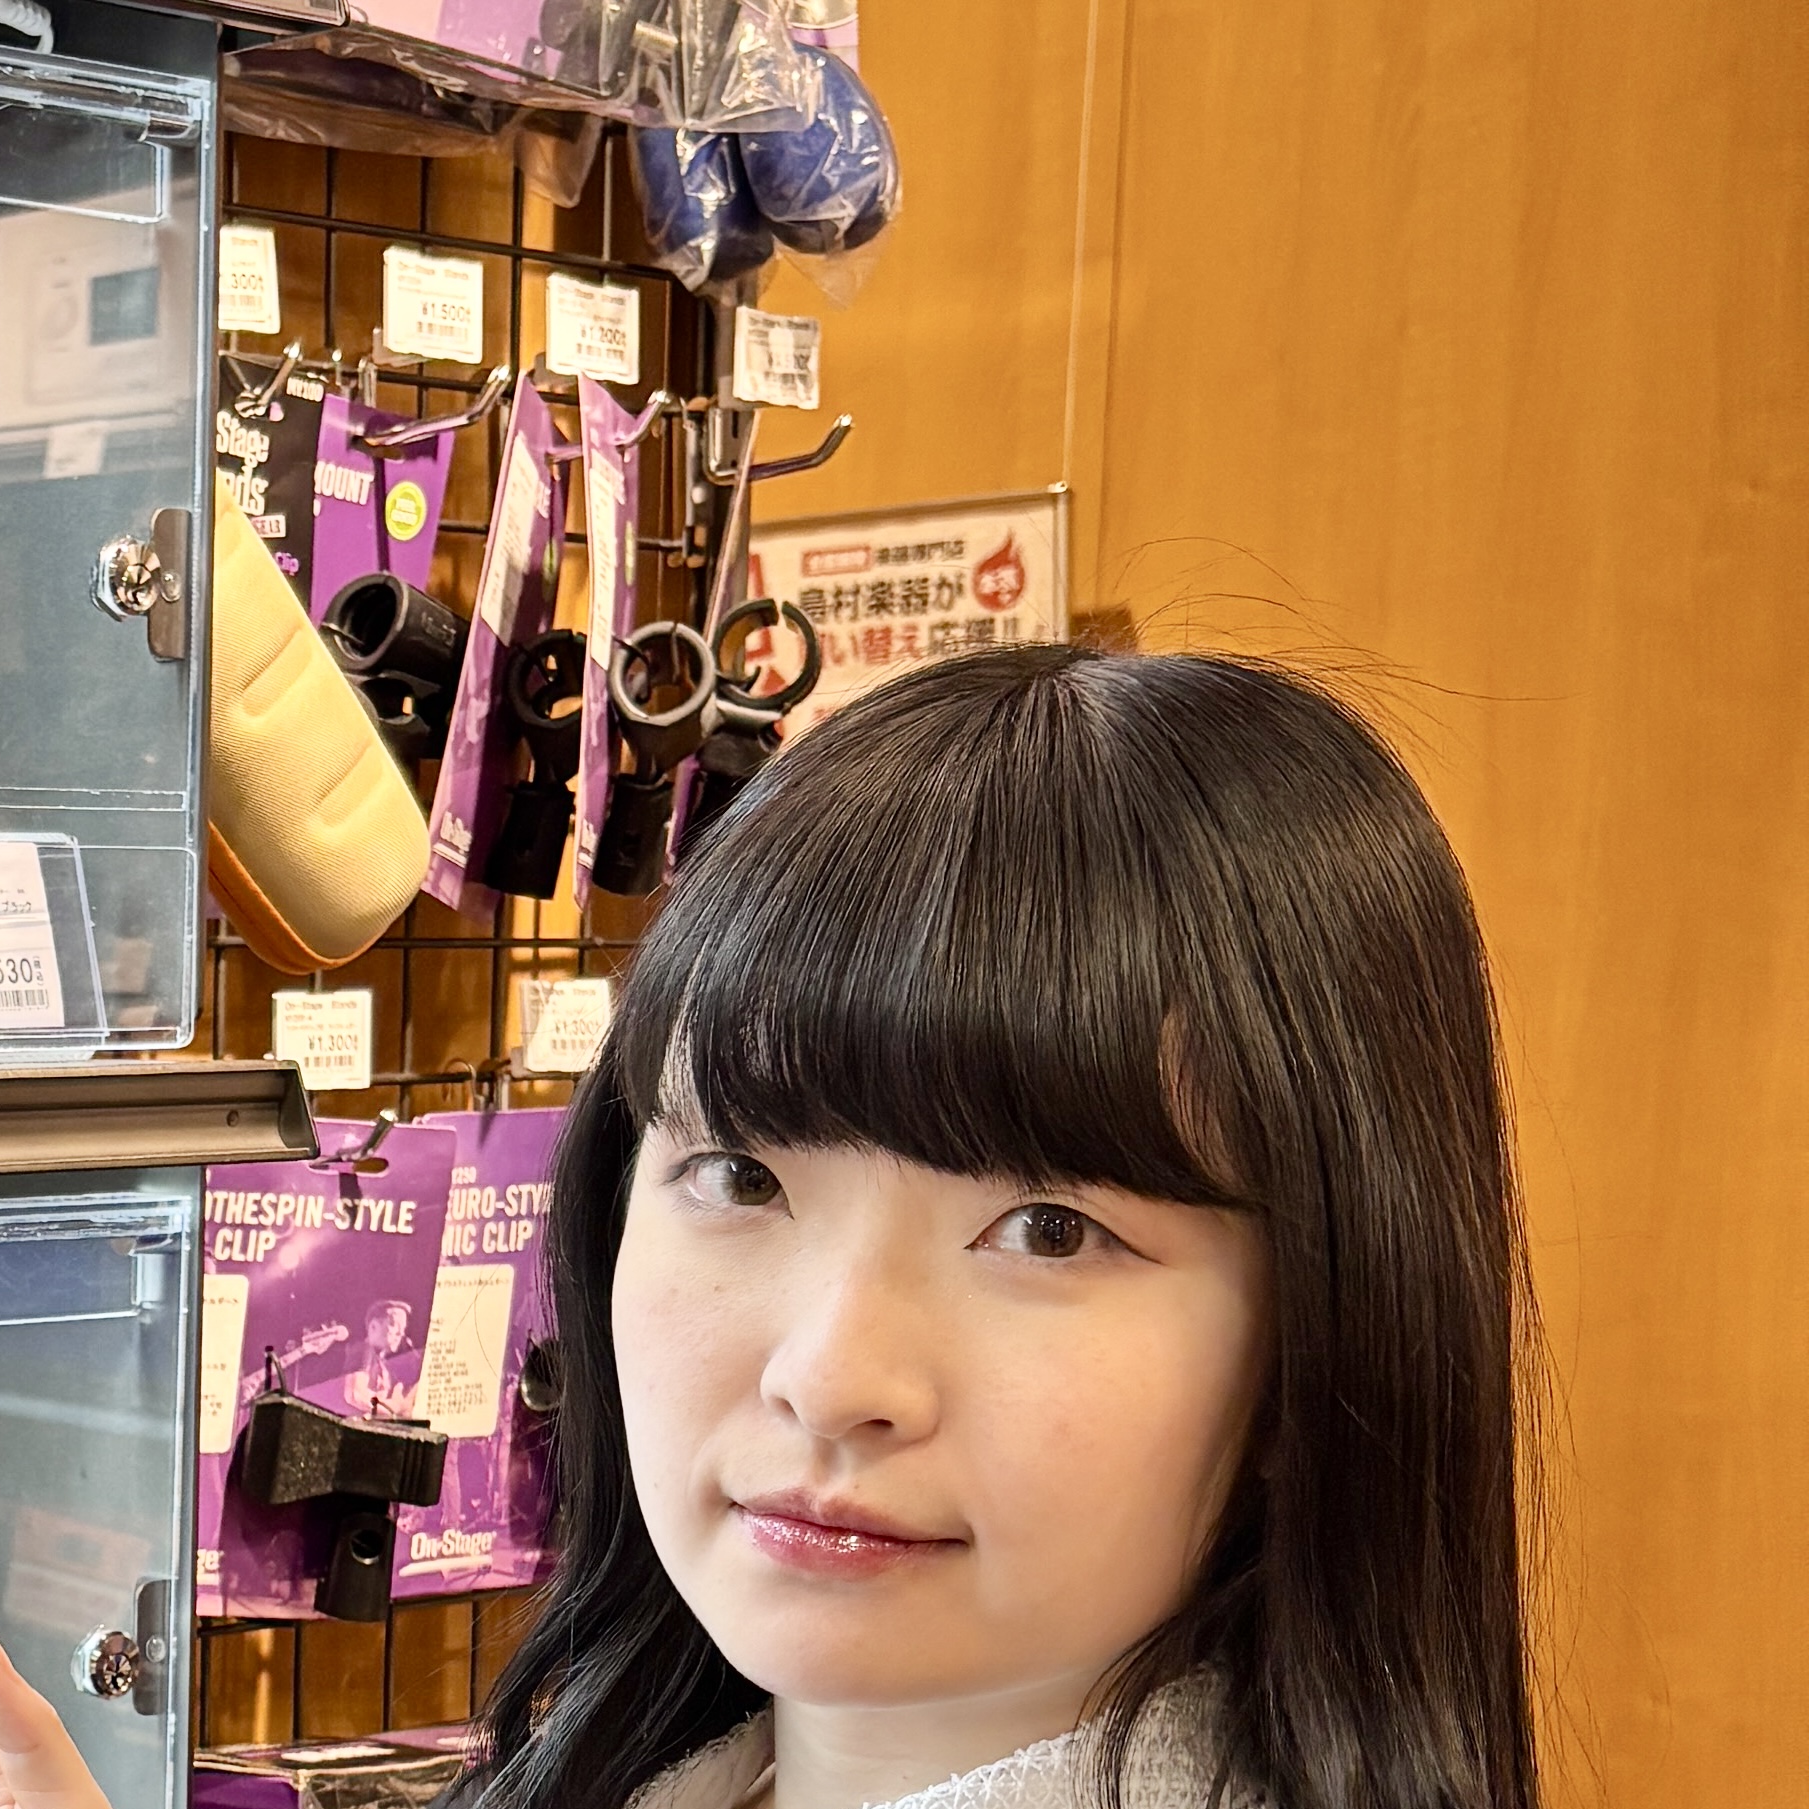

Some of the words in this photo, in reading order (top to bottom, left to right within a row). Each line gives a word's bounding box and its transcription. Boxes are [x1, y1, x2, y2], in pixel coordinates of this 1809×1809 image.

[216, 411, 269, 468] Stage
[2, 901, 32, 912] ブラック
[214, 1229, 276, 1262] CLIP
[482, 1220, 533, 1254] CLIP
